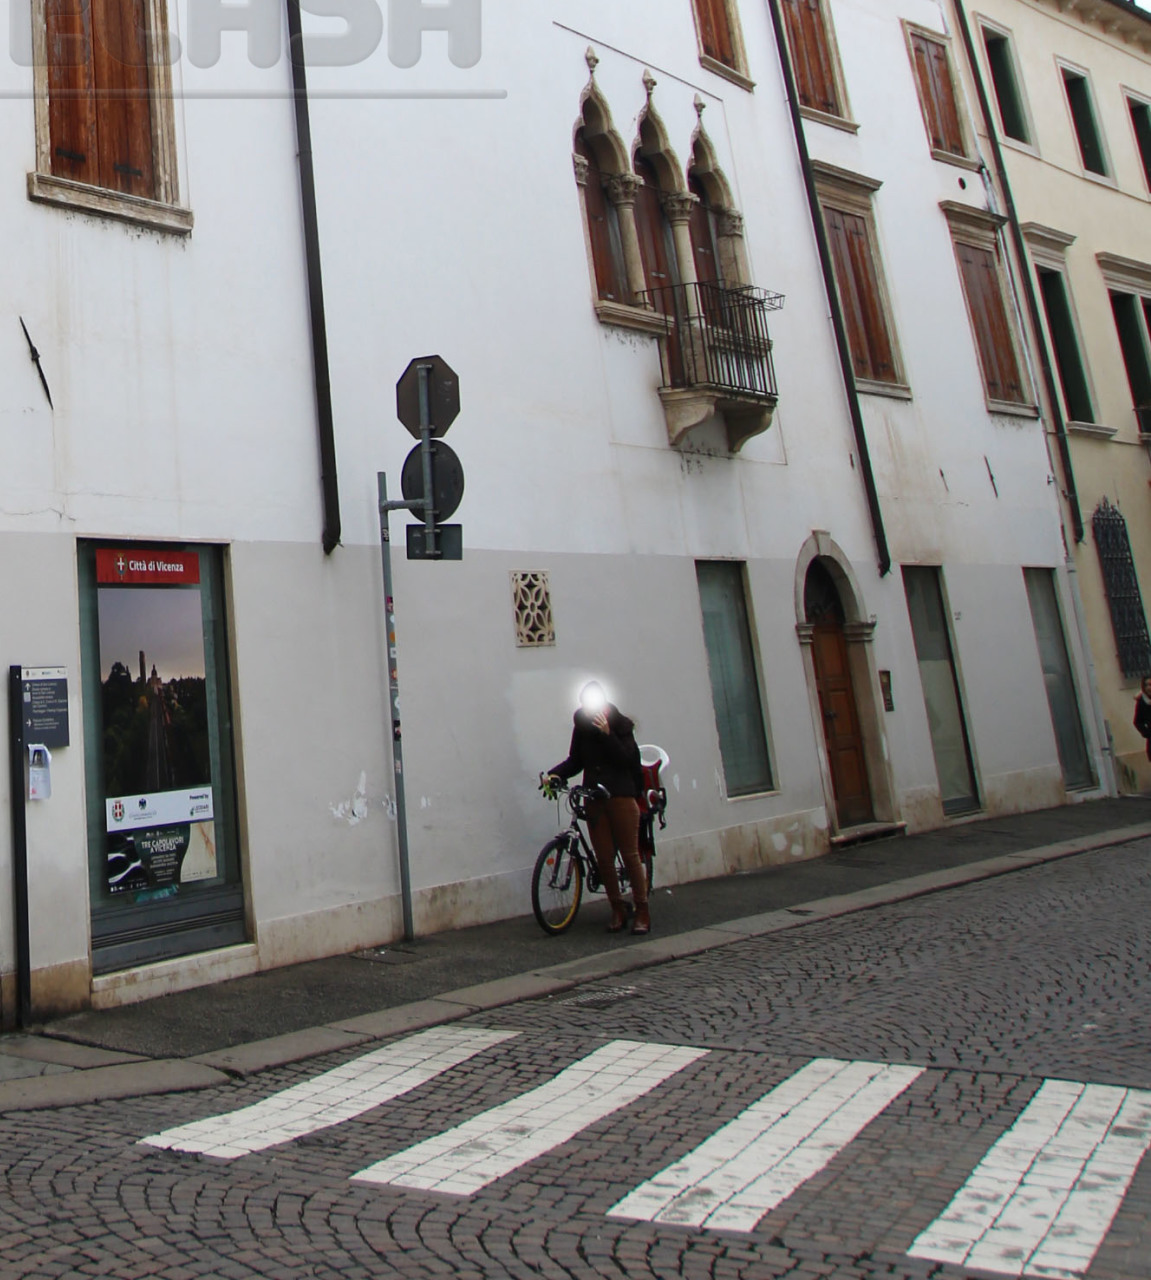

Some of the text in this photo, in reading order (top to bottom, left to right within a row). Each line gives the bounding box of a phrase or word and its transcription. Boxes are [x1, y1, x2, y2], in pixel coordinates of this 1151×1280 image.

[129, 560, 184, 573] Città di Vicenza
